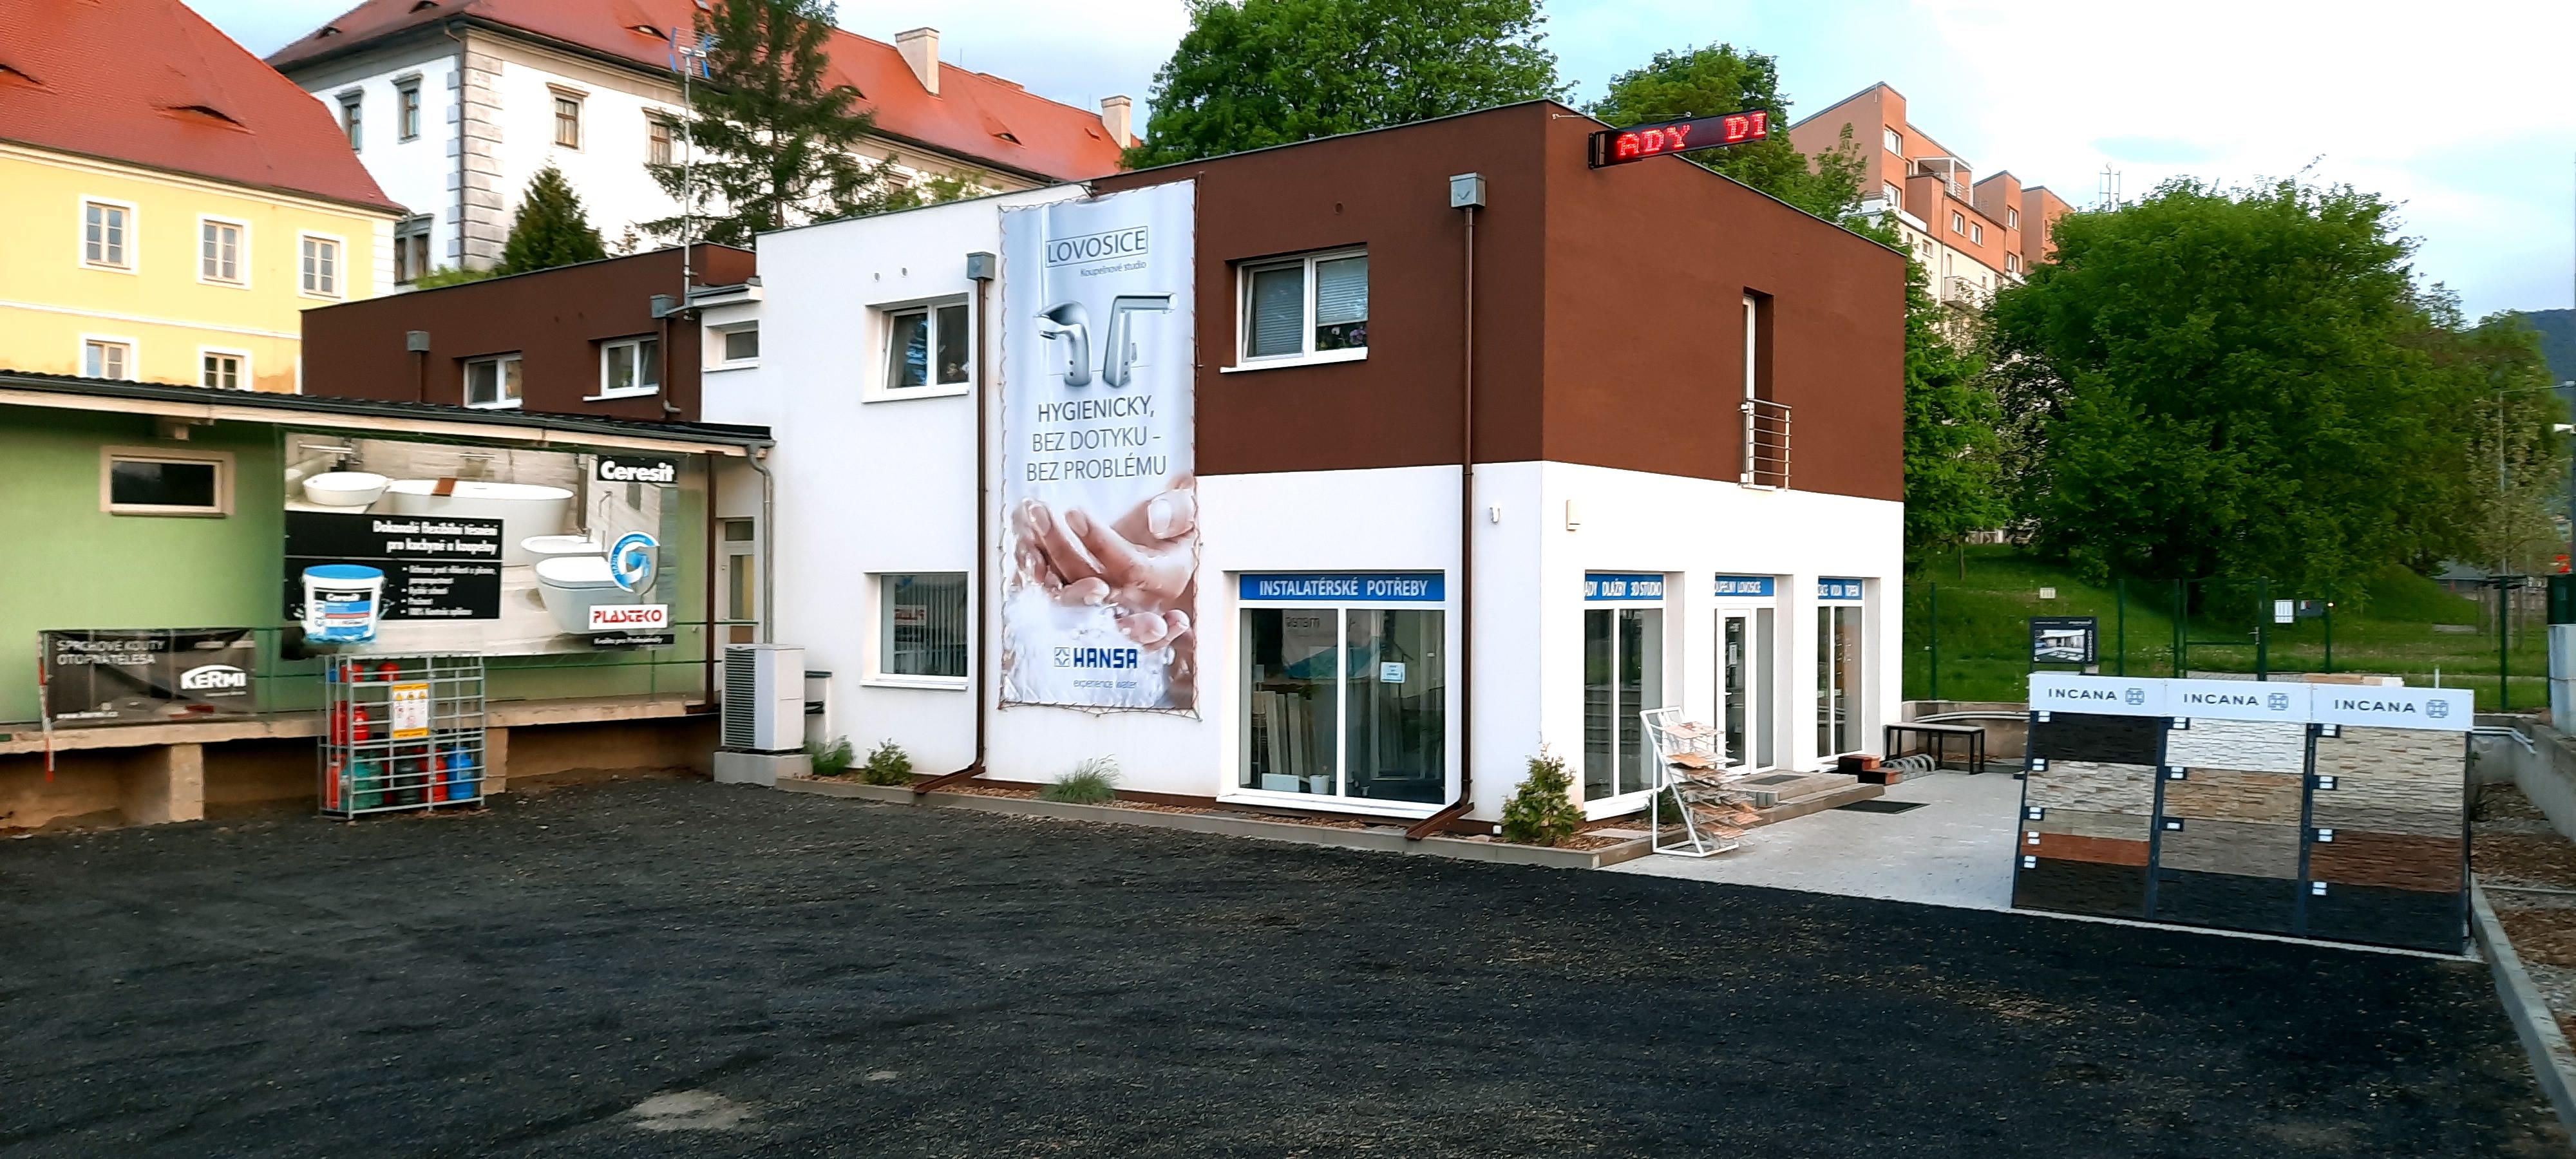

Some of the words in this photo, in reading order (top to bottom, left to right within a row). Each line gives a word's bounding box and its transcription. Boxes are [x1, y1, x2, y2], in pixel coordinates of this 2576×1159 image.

[1617, 124, 1690, 156] ADY
[1725, 111, 1767, 140] DI
[1047, 230, 1146, 263] LOVOSICE
[1037, 395, 1155, 423] HYGIENICKY,
[1032, 433, 1066, 452] BEZ
[1070, 426, 1148, 450] DOTYKU
[600, 461, 675, 482] Ceresit
[1026, 462, 1059, 482] BEZ
[1064, 451, 1167, 480] PROBLÉMU
[1259, 577, 1359, 596] INSTALATÉRSKÉ
[1367, 577, 1429, 596] POTŘEBY
[592, 610, 662, 624] PLASTEKO
[1074, 646, 1138, 669] HANSA
[181, 670, 247, 690] KERMI
[2048, 688, 2117, 701] INCANA
[2183, 693, 2259, 706] INCANA
[2334, 699, 2417, 713] INCANA
